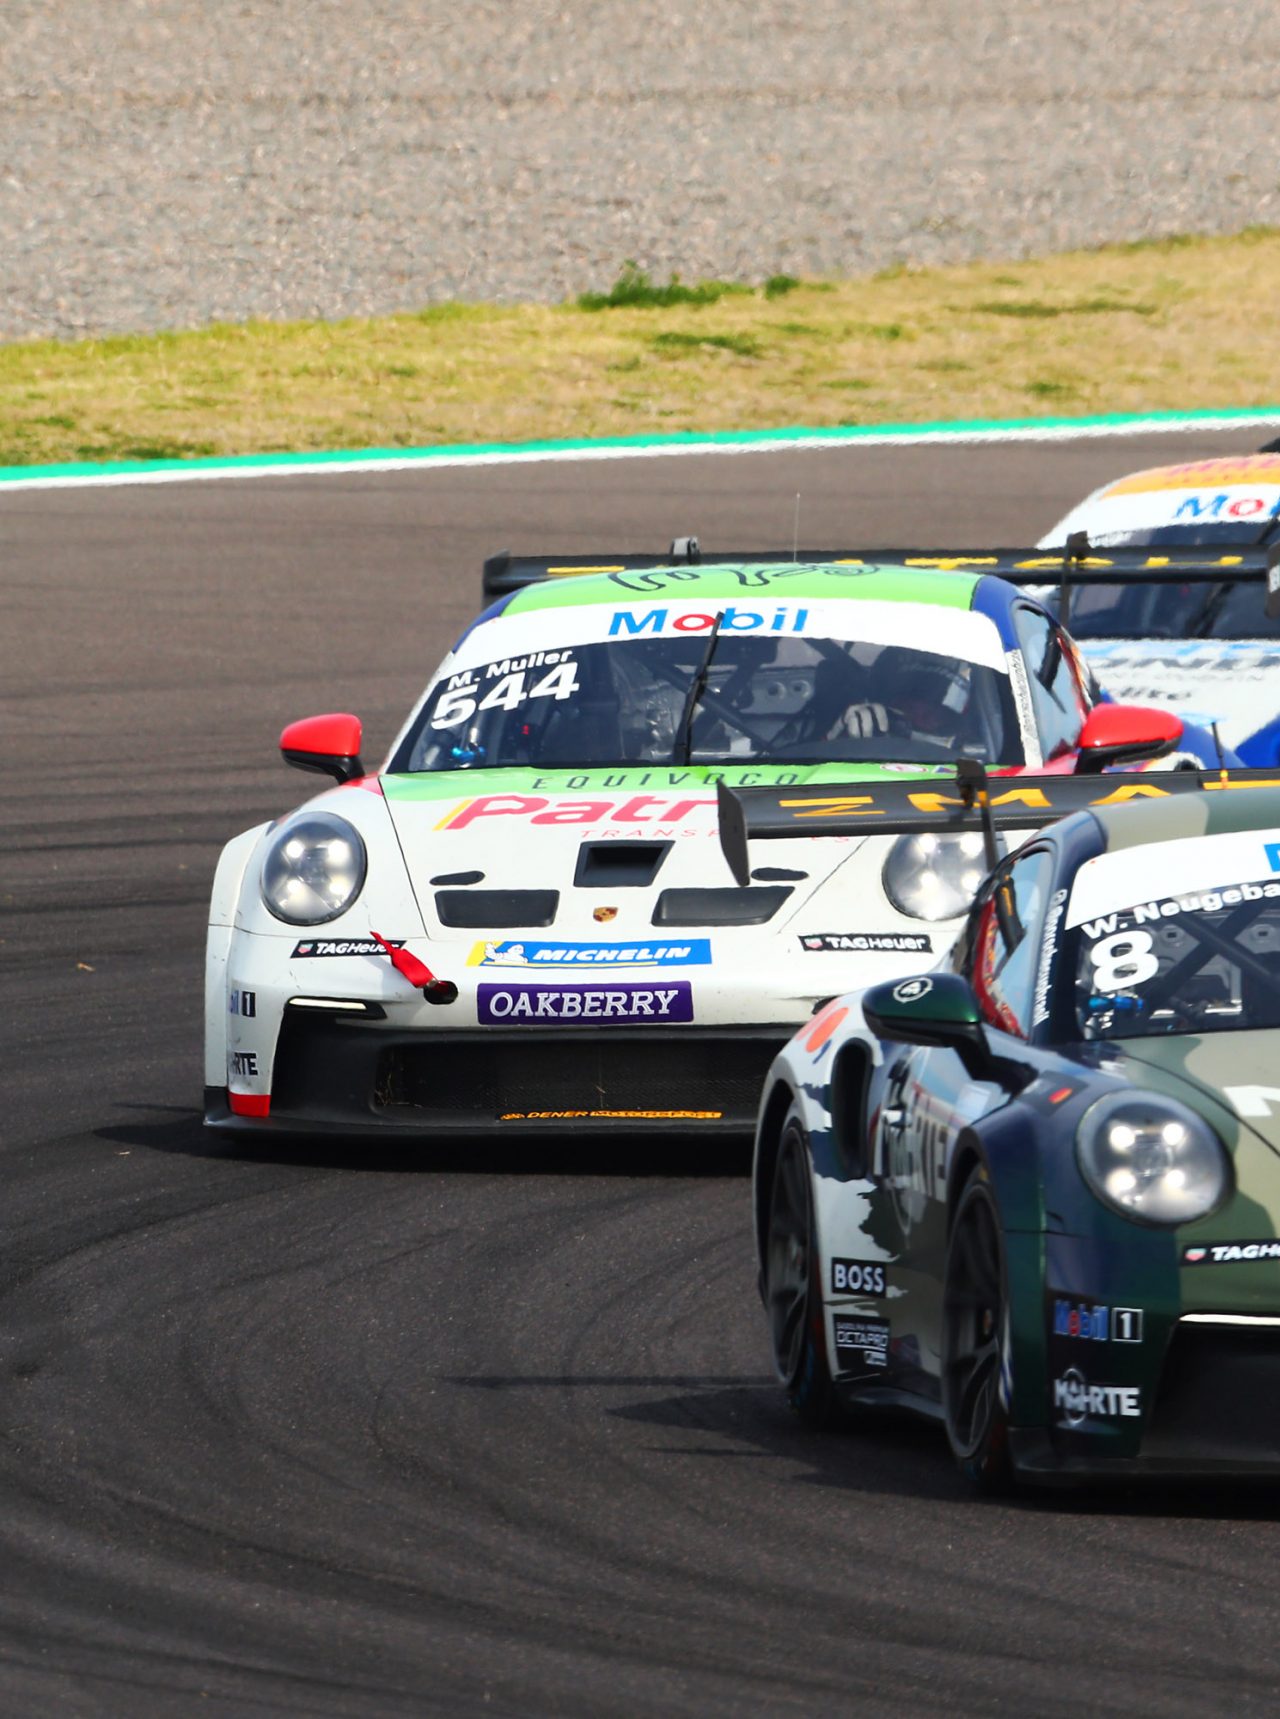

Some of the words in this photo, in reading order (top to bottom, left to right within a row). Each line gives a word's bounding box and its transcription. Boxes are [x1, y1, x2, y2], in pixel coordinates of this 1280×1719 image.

[608, 607, 808, 636] Mobil
[447, 674, 480, 692] M.
[486, 650, 573, 678] Muller
[431, 661, 580, 731] 544
[532, 772, 799, 790] EQUIVOCO
[1081, 914, 1129, 940] W.
[532, 946, 692, 963] MICHELIN
[1089, 930, 1160, 992] 8
[489, 989, 679, 1018] OAKBERRY
[834, 1263, 885, 1293] BOSS
[1054, 1300, 1108, 1341] Mobil
